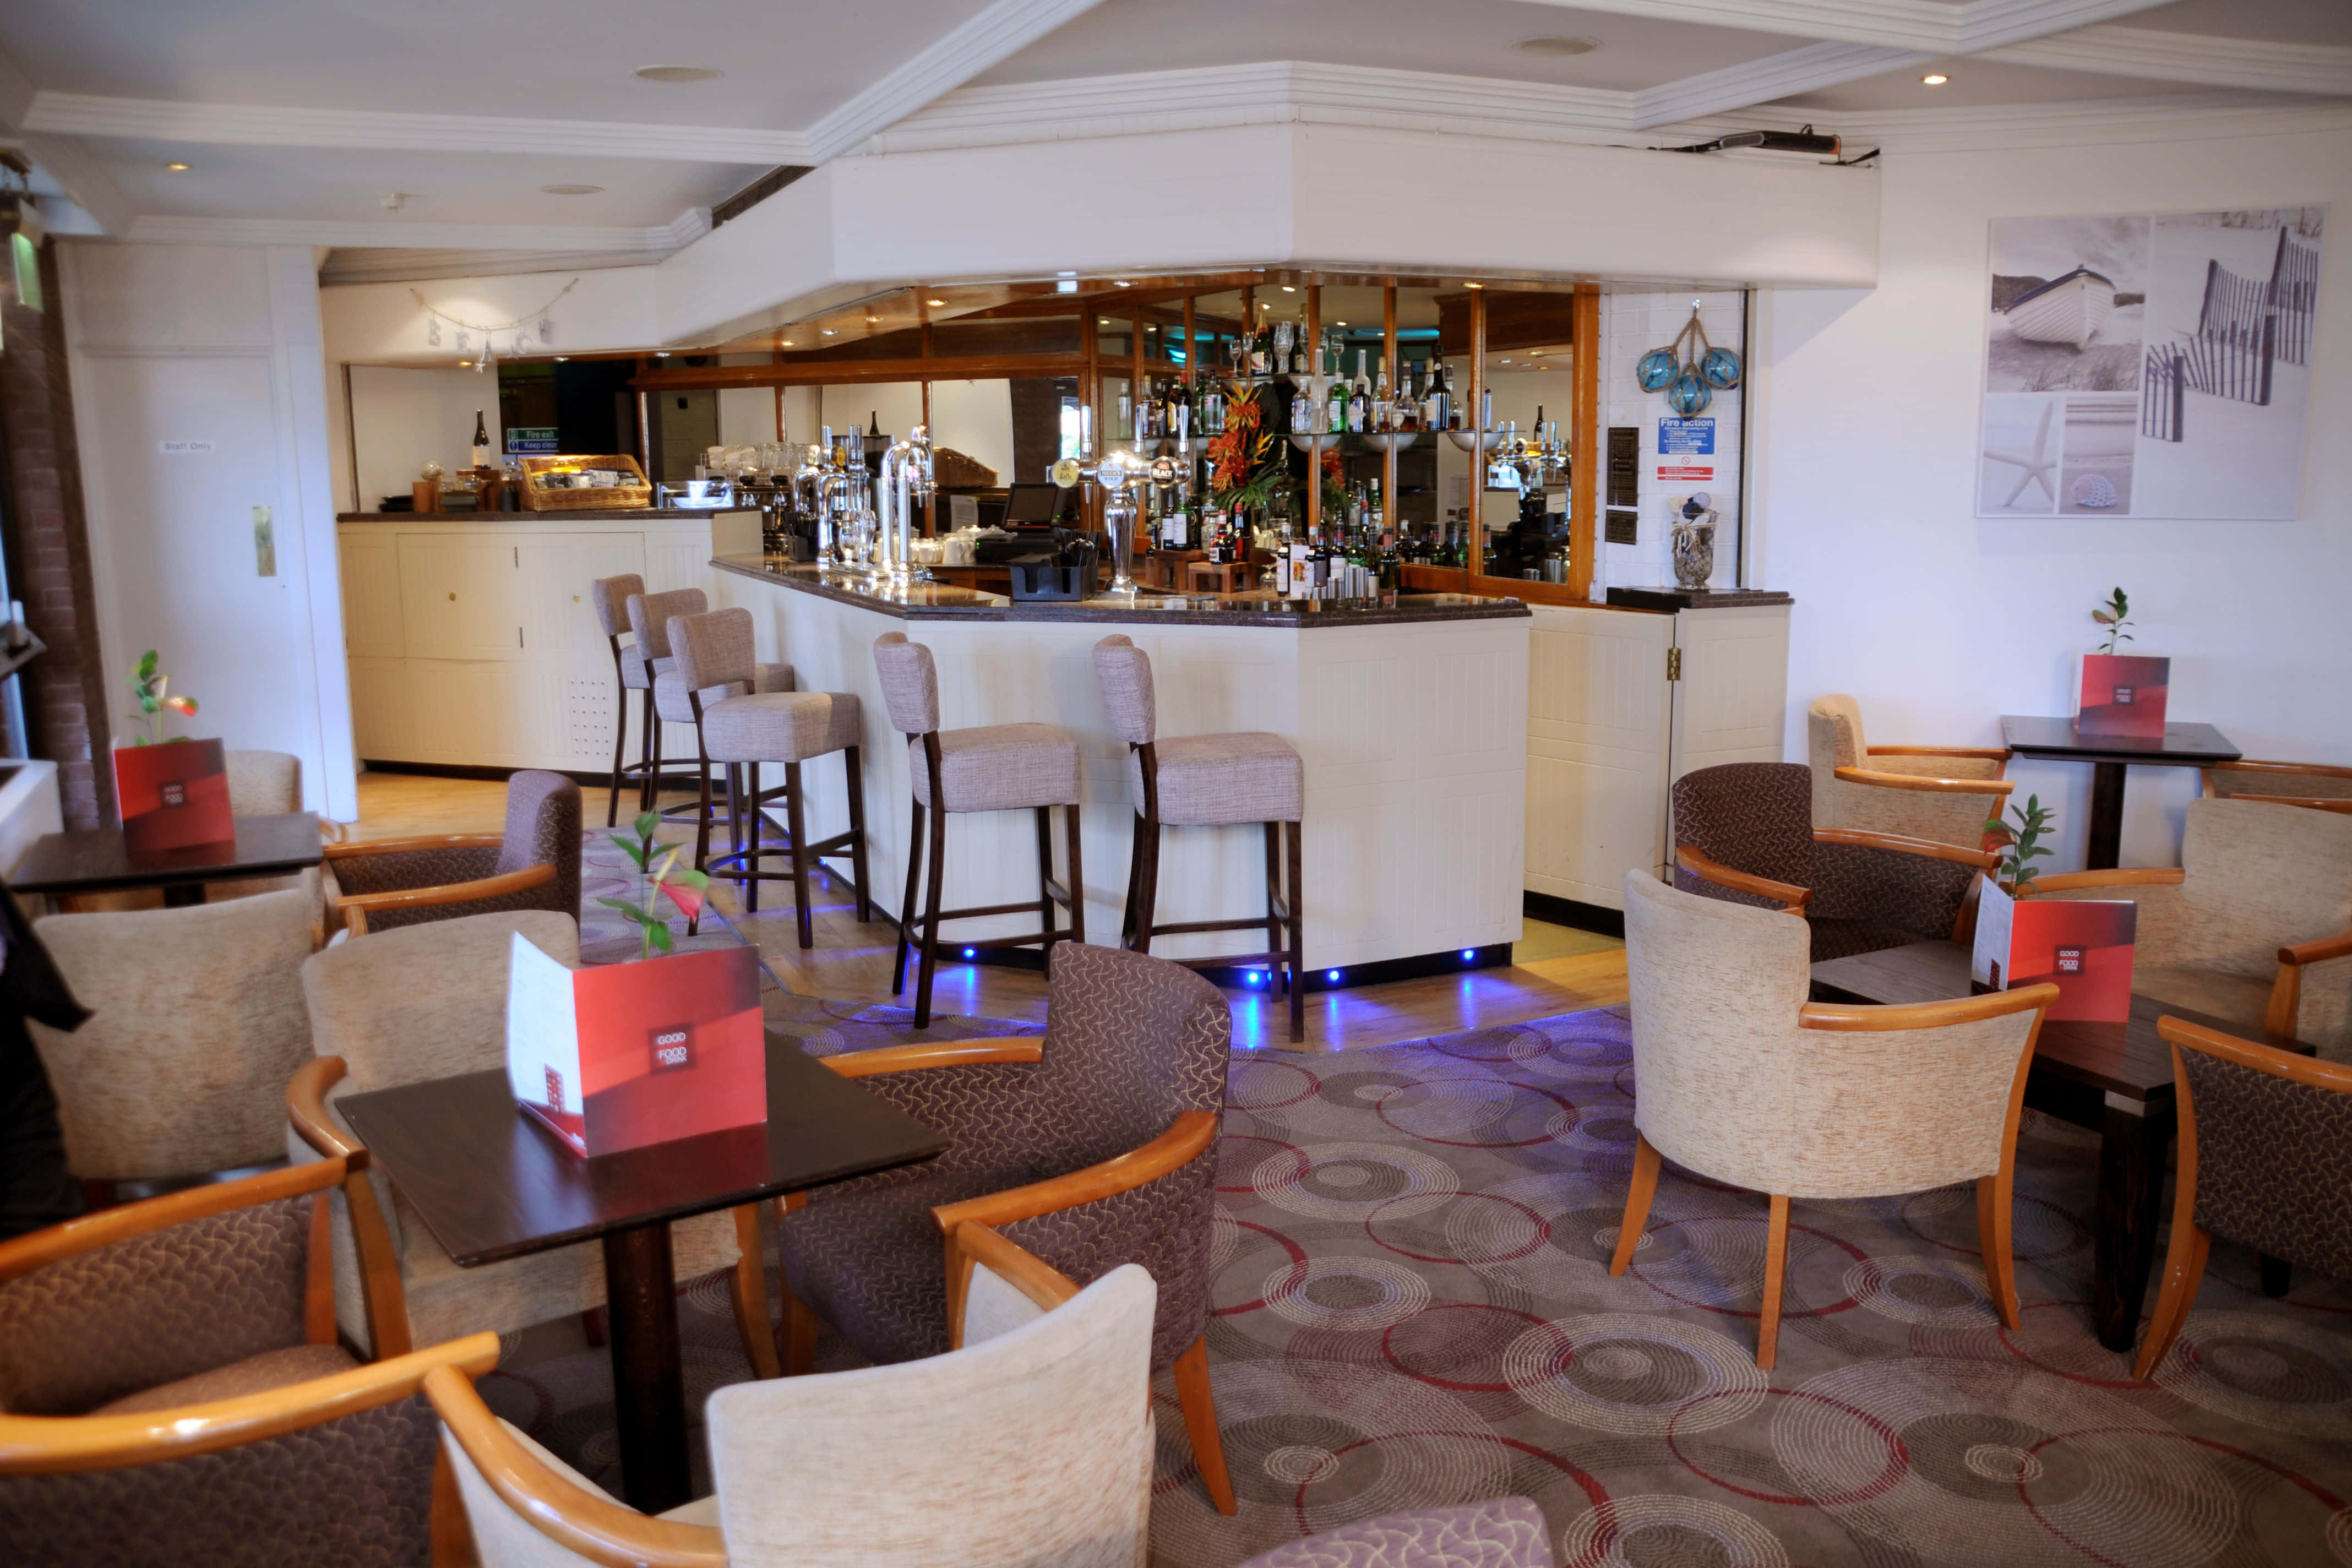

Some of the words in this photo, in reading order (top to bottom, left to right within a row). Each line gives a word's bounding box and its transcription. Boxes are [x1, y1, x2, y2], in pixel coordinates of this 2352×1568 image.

[1660, 418, 1680, 427] Fire
[1682, 418, 1713, 427] action
[190, 442, 211, 451] Only
[1153, 467, 1173, 477] BLACK
[658, 1032, 686, 1044] GOOD
[658, 1046, 687, 1060] FOOD
[666, 1055, 688, 1065] DRINK
